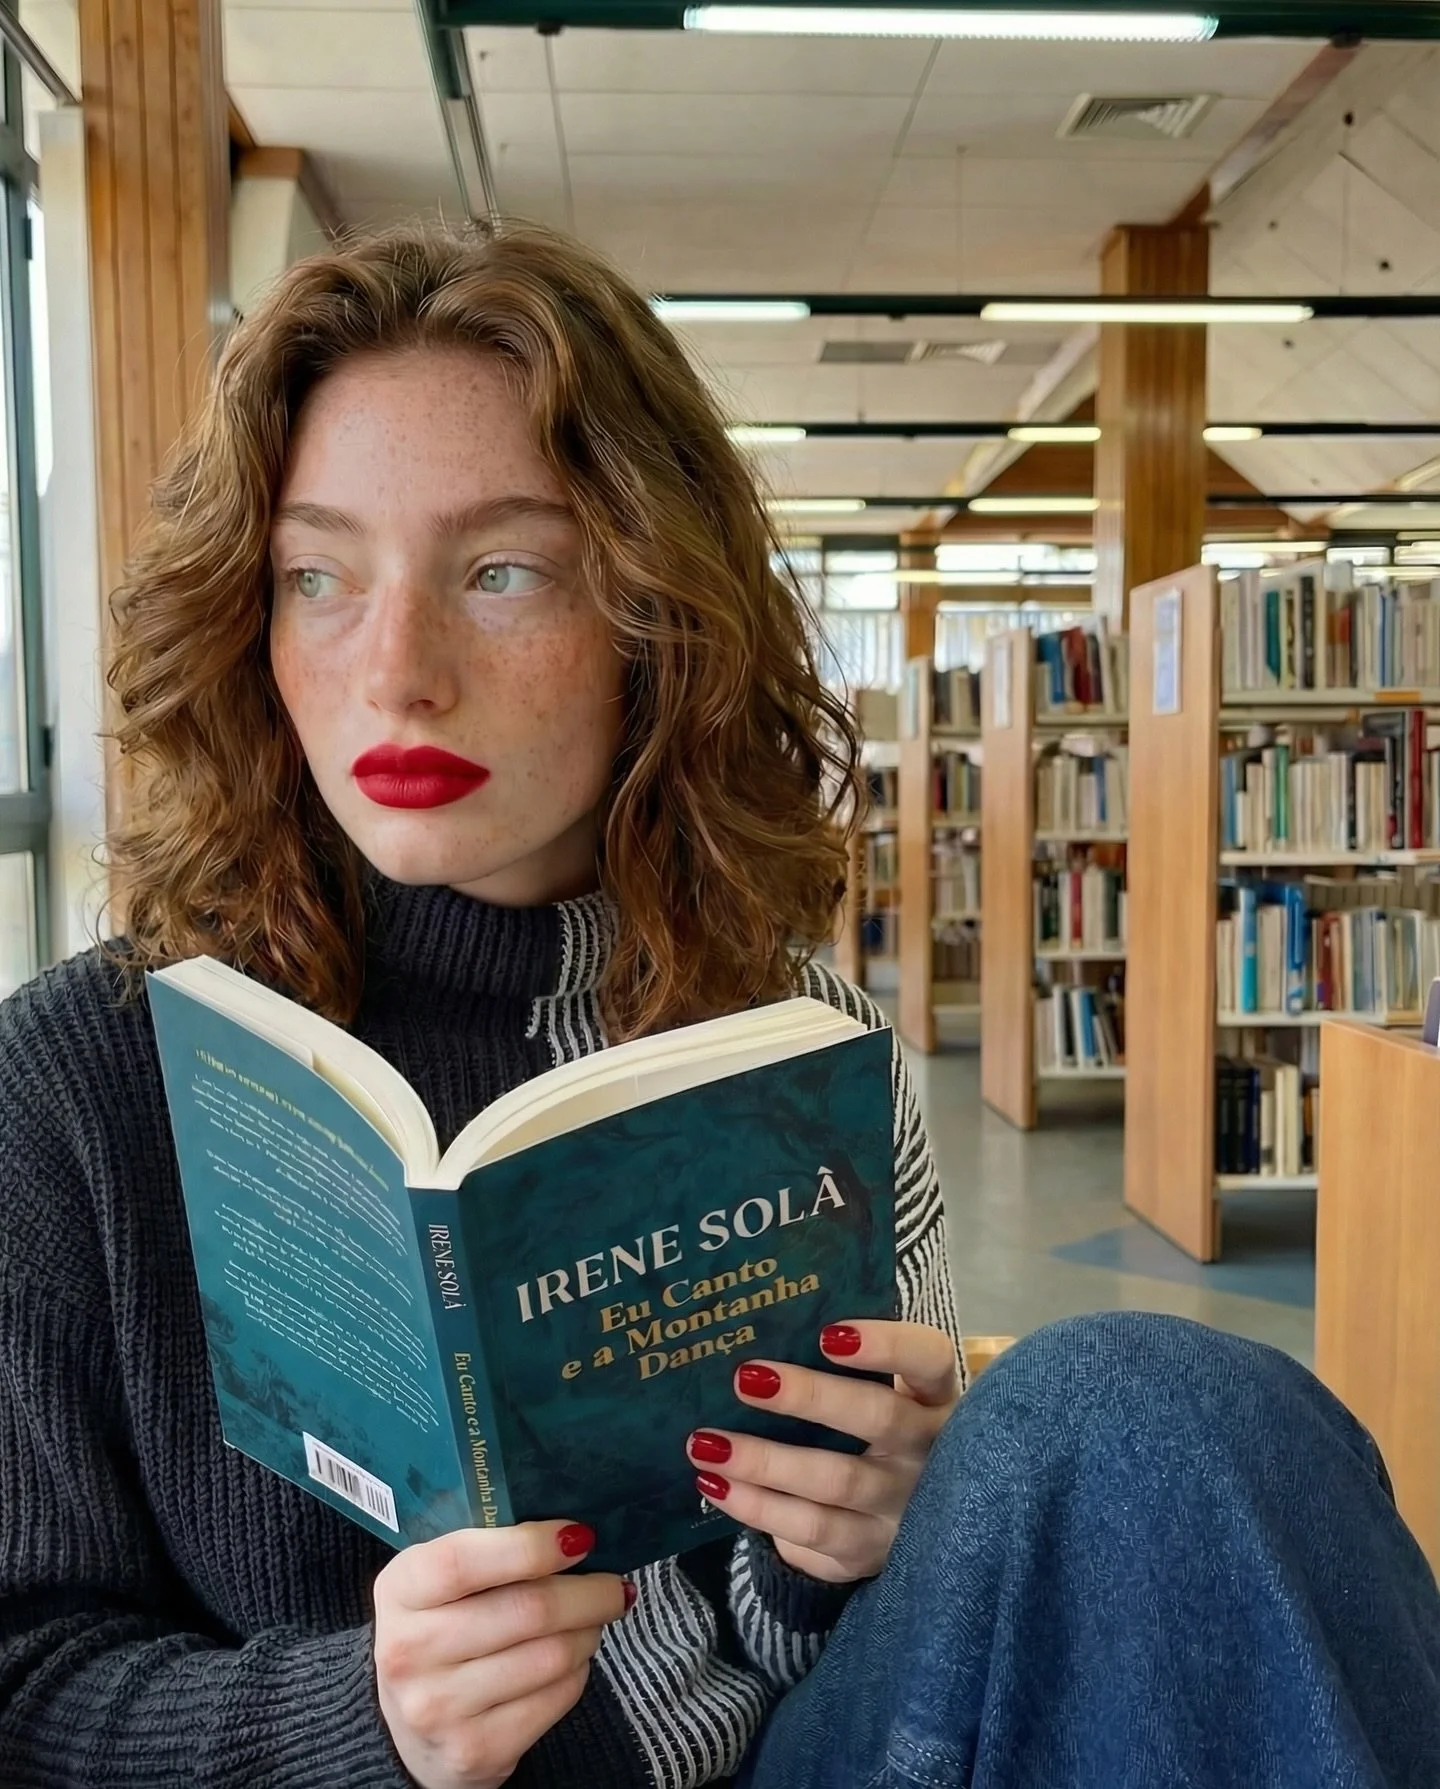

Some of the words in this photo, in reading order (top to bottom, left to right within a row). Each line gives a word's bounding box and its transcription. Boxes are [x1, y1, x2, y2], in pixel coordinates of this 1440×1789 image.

[428, 1224, 455, 1268] IRENE
[516, 1224, 682, 1323] IRENE
[600, 1299, 652, 1333] Eu
[662, 1257, 778, 1308] Canto
[562, 1359, 582, 1380] e
[593, 1346, 614, 1368] a
[626, 1272, 820, 1355] Montanha
[638, 1325, 757, 1381] Dança
[454, 1352, 471, 1370] Eu
[458, 1374, 478, 1414] Canto
[471, 1439, 495, 1502] Montanha
